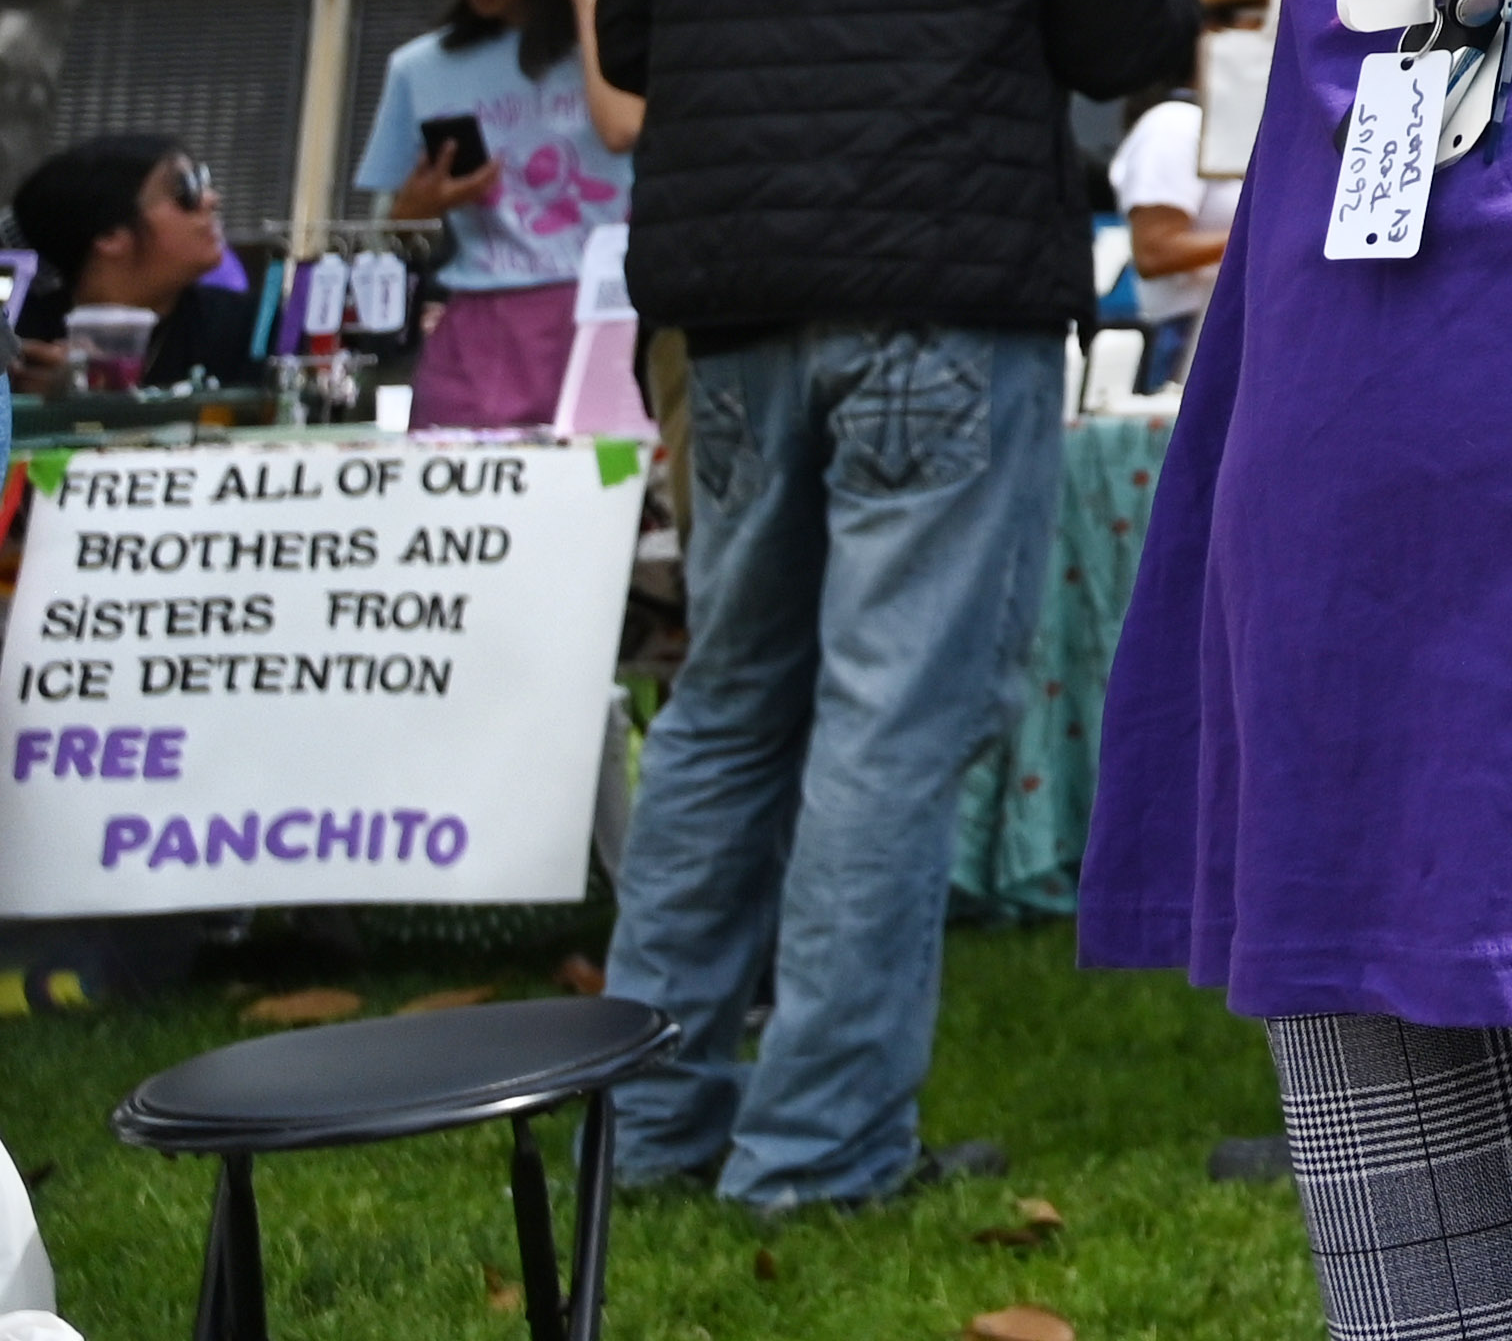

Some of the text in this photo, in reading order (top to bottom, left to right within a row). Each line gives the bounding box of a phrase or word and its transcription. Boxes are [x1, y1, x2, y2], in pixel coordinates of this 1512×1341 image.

[58, 456, 528, 511] FREE ALL OF OUR
[75, 525, 511, 573] BROTHERS AND
[326, 590, 469, 634] FROM
[18, 653, 453, 704] ICE DETENTION
[13, 725, 187, 782] FREE
[101, 808, 469, 868] PANCHITO
